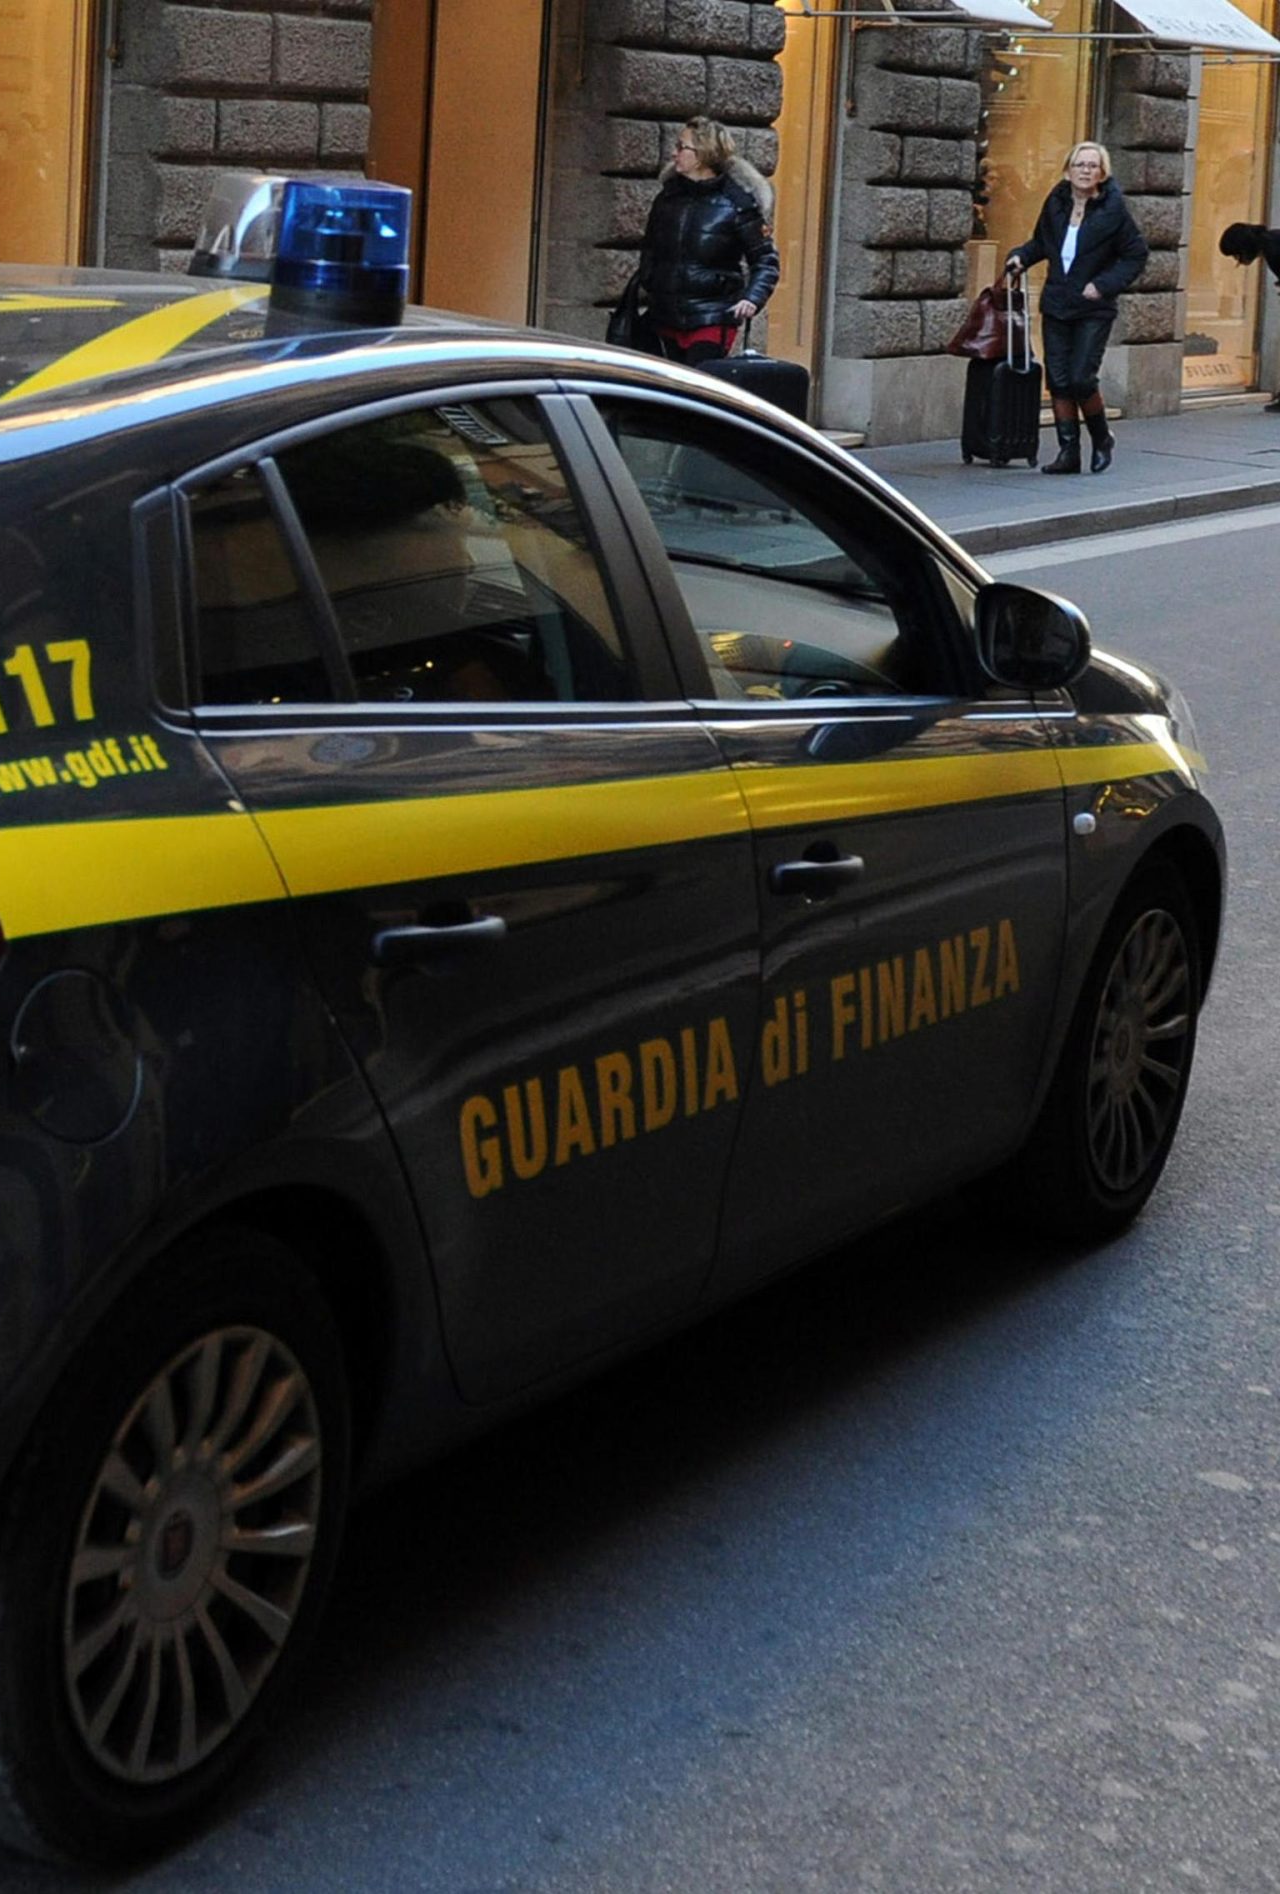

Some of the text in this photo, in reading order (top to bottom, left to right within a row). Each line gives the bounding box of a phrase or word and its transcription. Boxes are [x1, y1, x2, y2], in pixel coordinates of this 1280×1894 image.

[459, 919, 1019, 1199] GUARDIA di FINANZA
